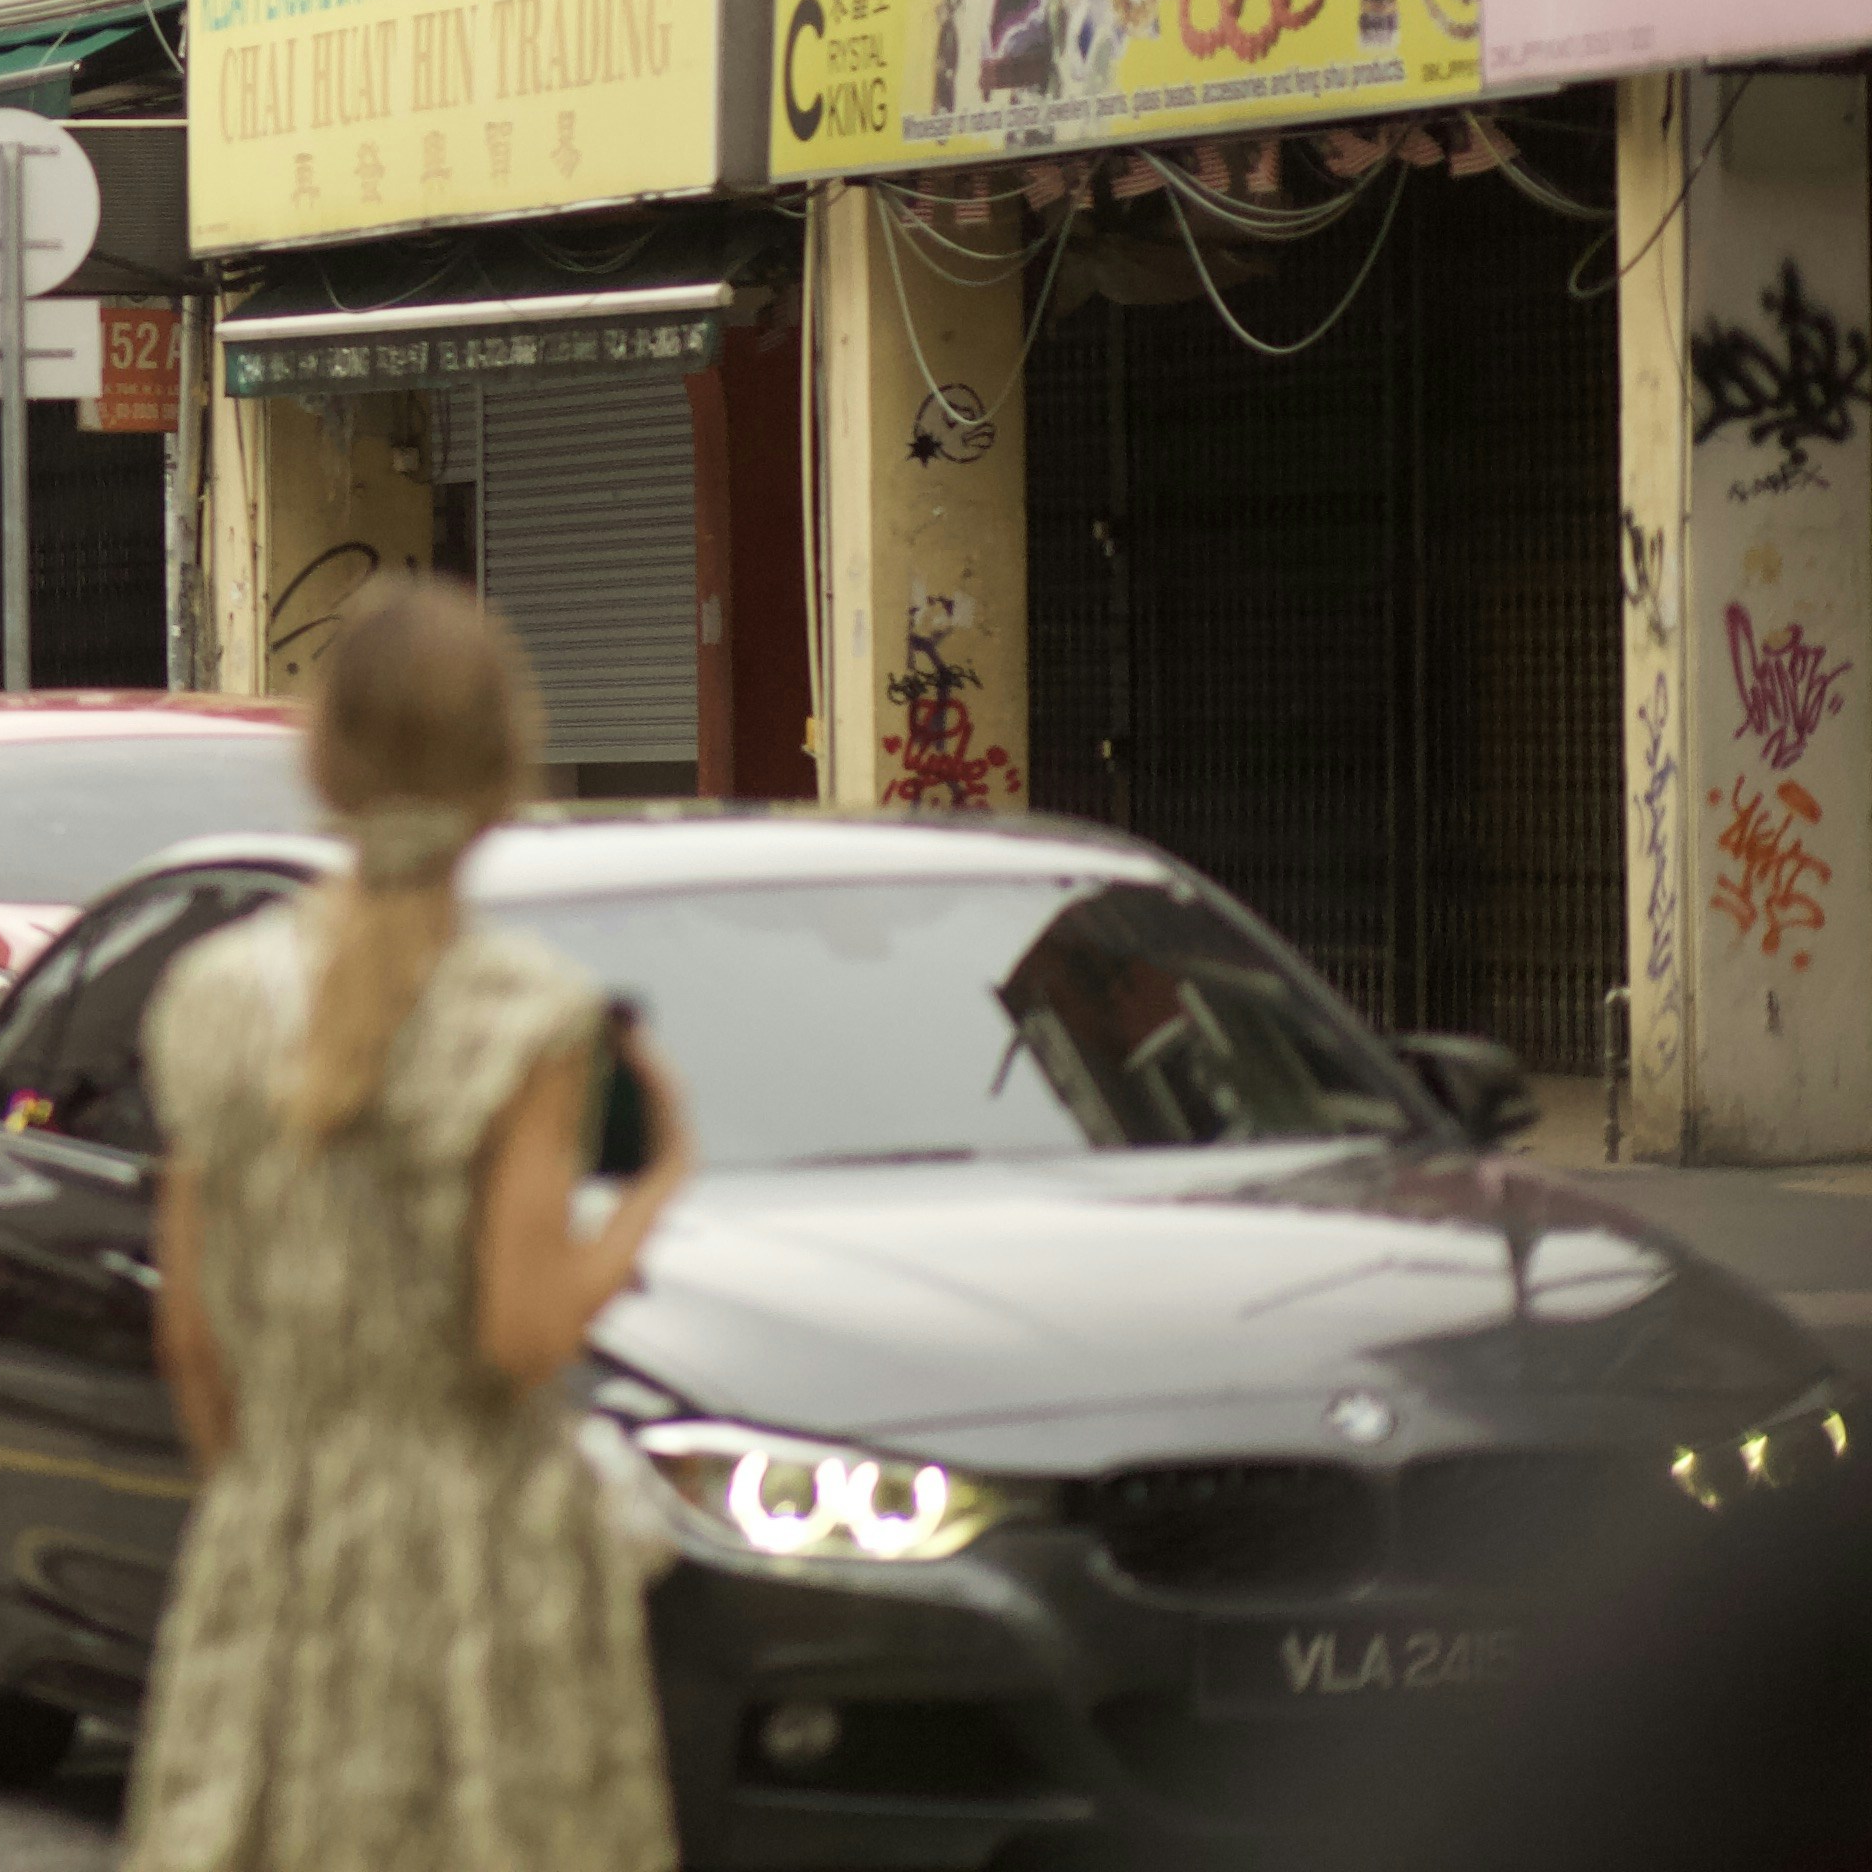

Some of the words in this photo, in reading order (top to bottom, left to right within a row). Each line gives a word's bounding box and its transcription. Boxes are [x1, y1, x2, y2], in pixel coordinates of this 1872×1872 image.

[219, 39, 296, 145] CHAI
[311, 19, 398, 129] HUAT
[411, 5, 478, 113] HIN
[826, 76, 889, 138] KING
[1283, 1631, 1392, 1694] VLA
